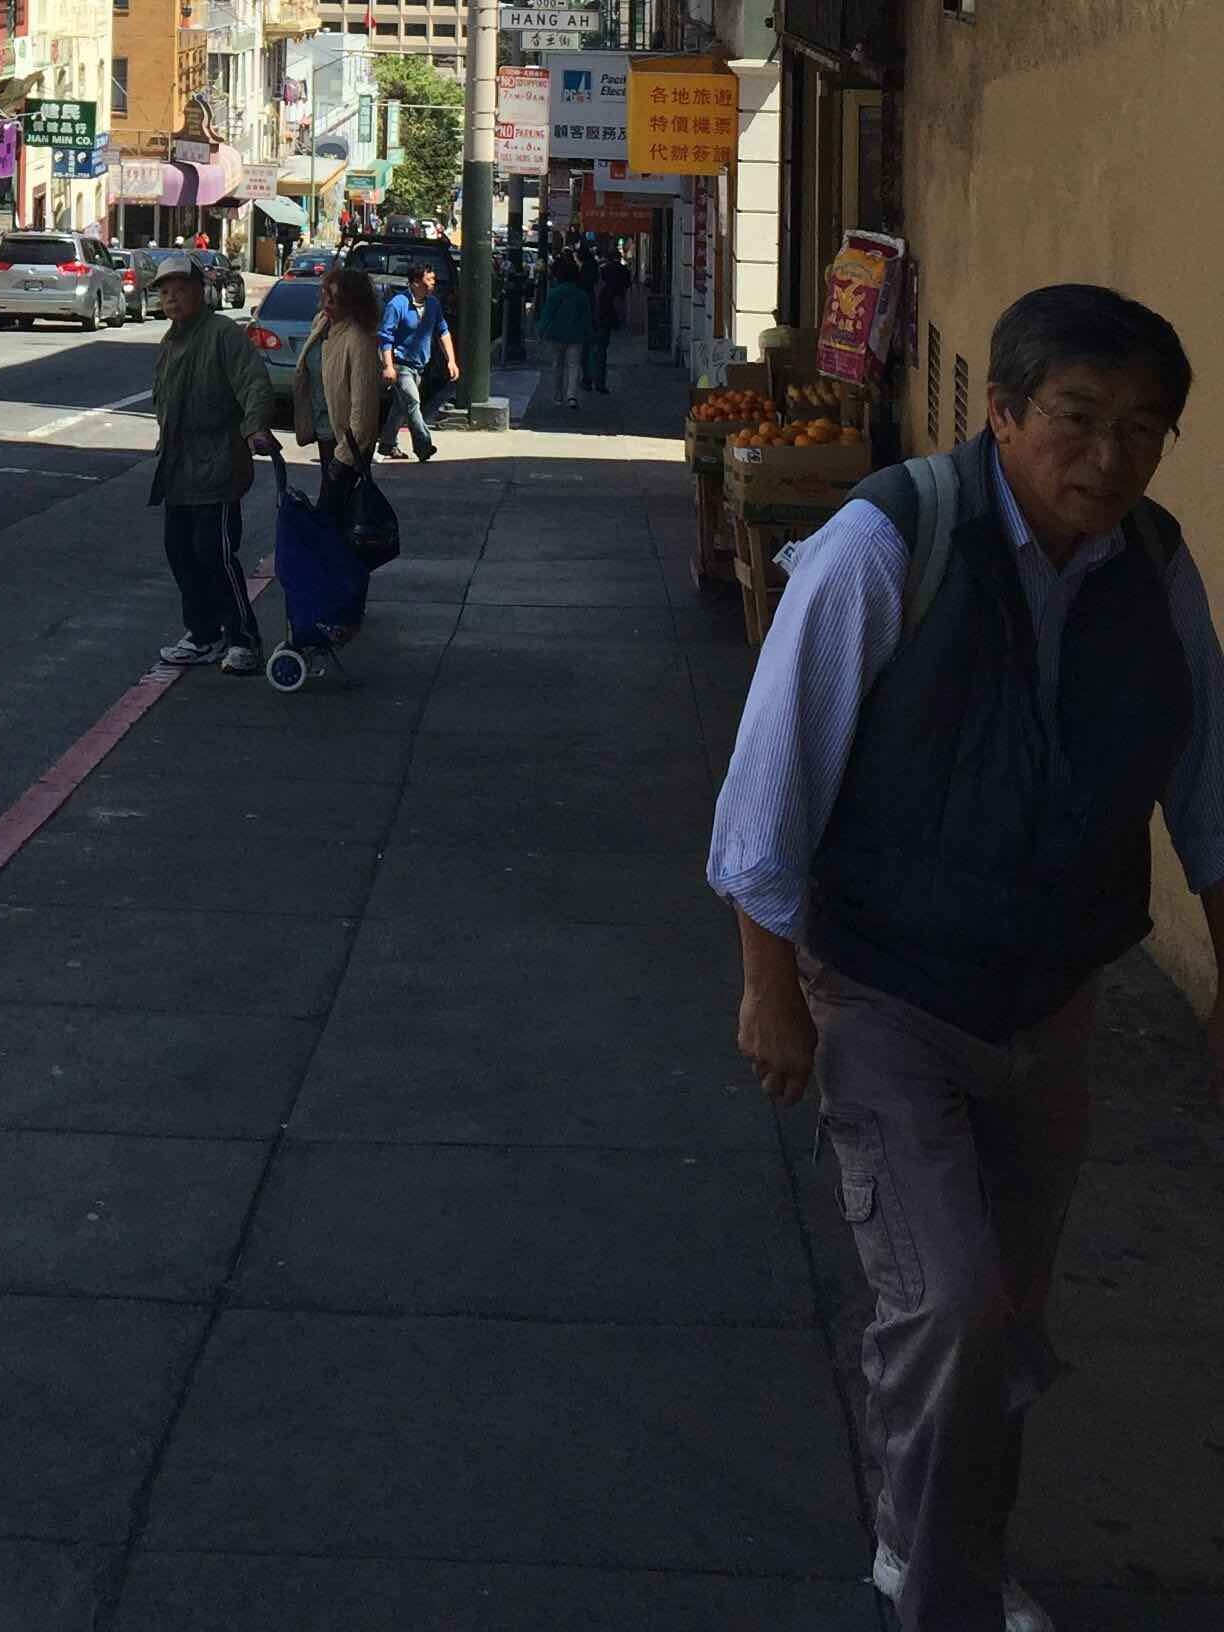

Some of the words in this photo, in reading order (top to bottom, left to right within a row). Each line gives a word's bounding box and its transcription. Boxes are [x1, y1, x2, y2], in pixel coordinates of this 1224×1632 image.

[511, 13, 559, 27] HANG
[567, 15, 590, 28] AH
[649, 87, 733, 106] 各地旅遊
[499, 124, 514, 138] NO
[26, 134, 49, 144] JIAN
[52, 135, 73, 145] MIN
[75, 136, 93, 146] CO.
